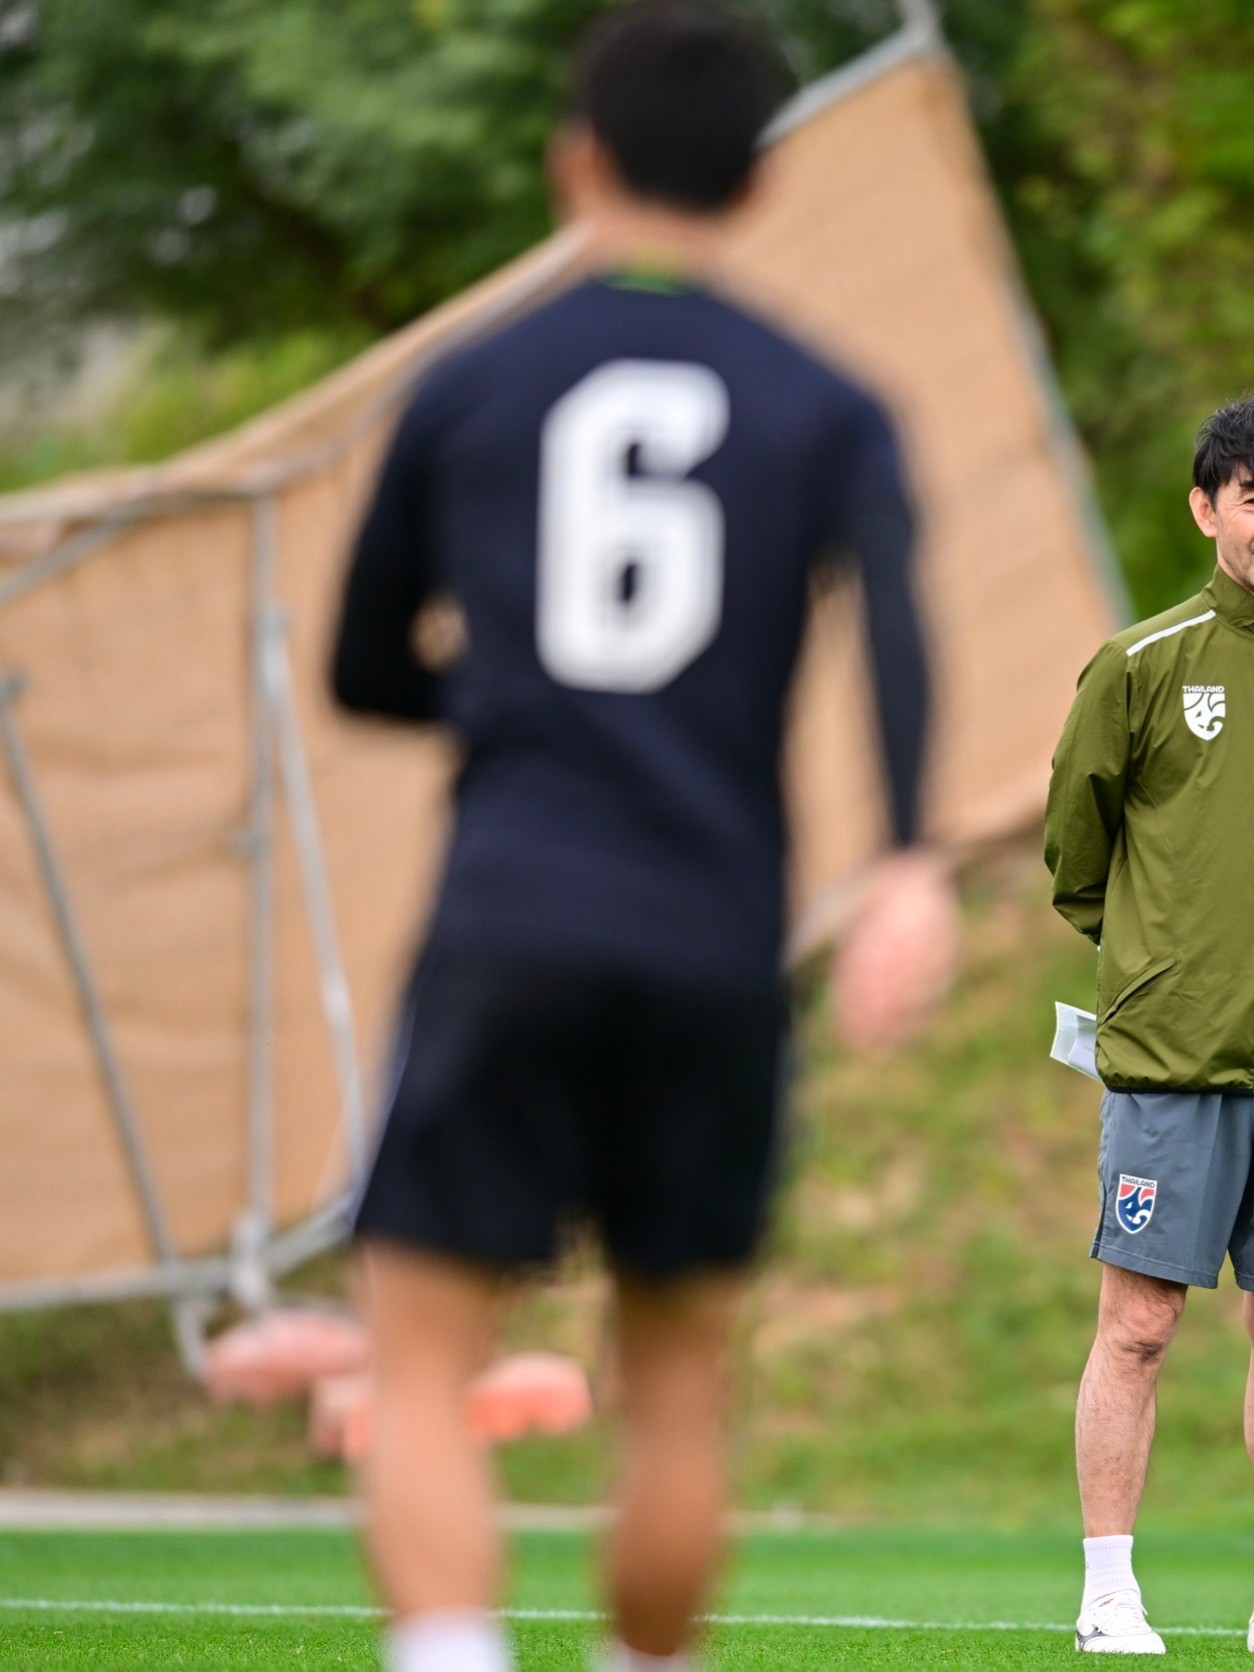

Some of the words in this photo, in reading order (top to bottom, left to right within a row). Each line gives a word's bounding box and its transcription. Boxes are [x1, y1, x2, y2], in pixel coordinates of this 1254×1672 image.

[536, 358, 730, 694] 6
[1182, 685, 1225, 693] THAILAND
[1121, 1176, 1156, 1189] THAILAND
